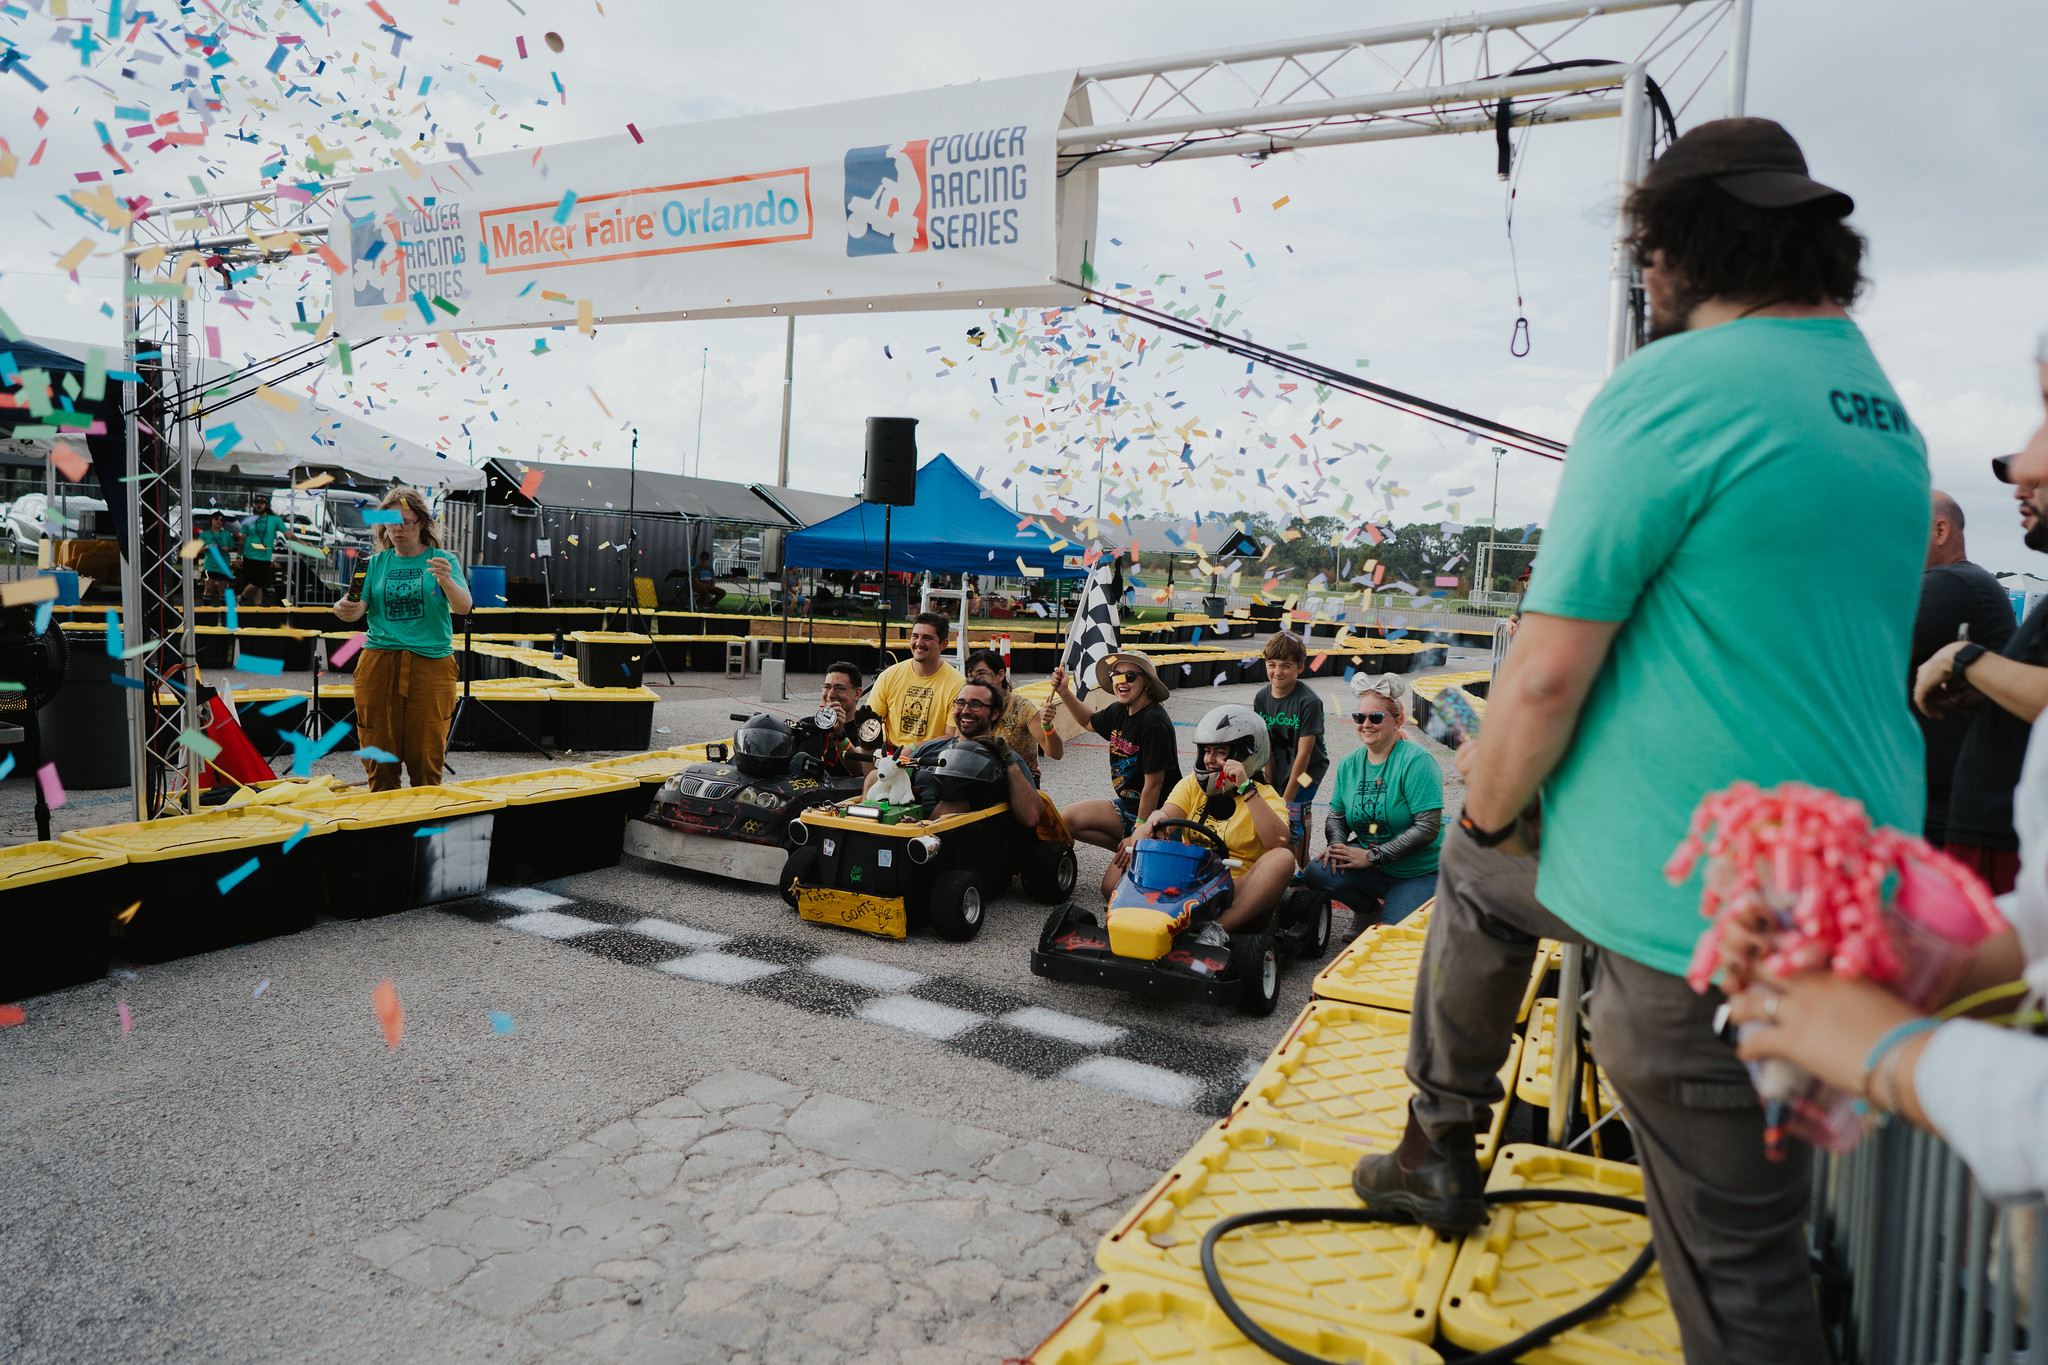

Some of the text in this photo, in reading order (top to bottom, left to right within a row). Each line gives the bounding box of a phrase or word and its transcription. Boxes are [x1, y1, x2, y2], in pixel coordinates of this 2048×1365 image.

[930, 126, 1028, 167] POWER
[931, 164, 1027, 209] RACING
[491, 189, 799, 258] Maker Faire Orlando
[930, 208, 1018, 251] SERIES
[405, 235, 466, 269] RACING
[408, 270, 463, 302] SERIES
[1829, 389, 1911, 435] CREW
[788, 778, 819, 791] 3538
[840, 900, 877, 923] GOATS
